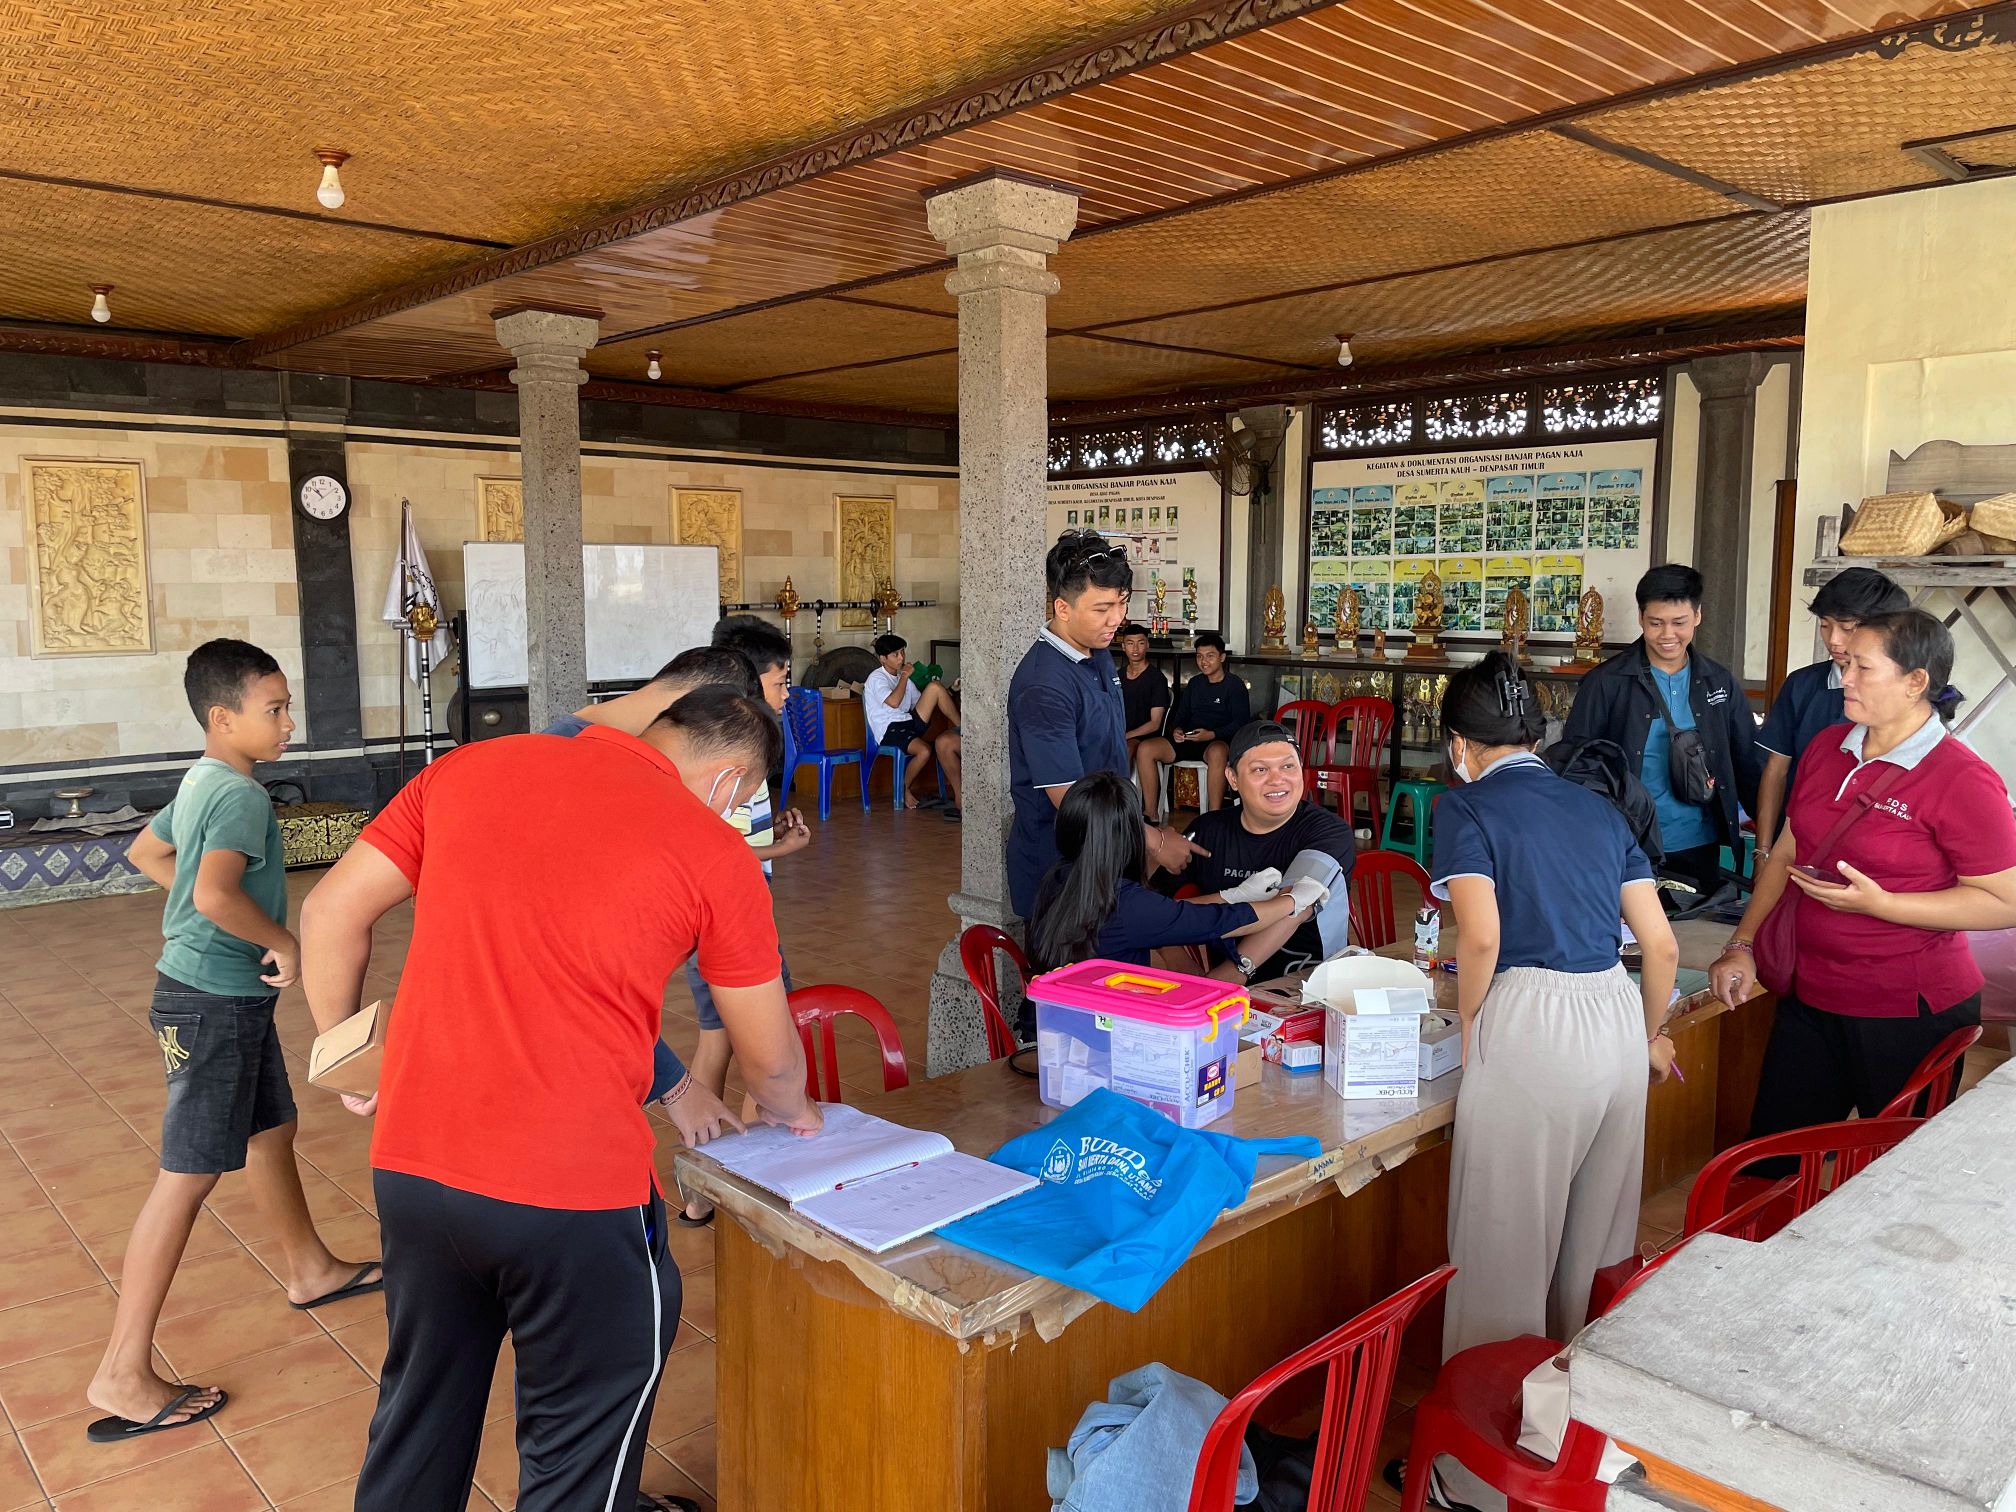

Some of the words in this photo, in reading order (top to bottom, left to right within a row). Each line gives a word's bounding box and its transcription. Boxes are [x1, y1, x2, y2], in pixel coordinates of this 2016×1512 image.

[1366, 461, 1399, 470] KEGIATAN
[1407, 457, 1457, 467] DOKUMENTASI
[1458, 454, 1503, 464] ORGANISASI
[1504, 453, 1533, 461] BANJAR
[1535, 451, 1562, 459] PAGAN
[1563, 449, 1584, 458] KAJA
[1397, 470, 1415, 478] DESA
[1416, 468, 1449, 476] SUMERTA
[1479, 463, 1518, 473] DENPASAR
[1521, 462, 1545, 470] TIMUR
[1072, 482, 1109, 491] ORGANISASI
[1110, 480, 1135, 489] BANJAR
[1136, 479, 1158, 487] PAGAN
[1160, 478, 1177, 486] KAJA
[1128, 1172, 1158, 1195] UTAMA
